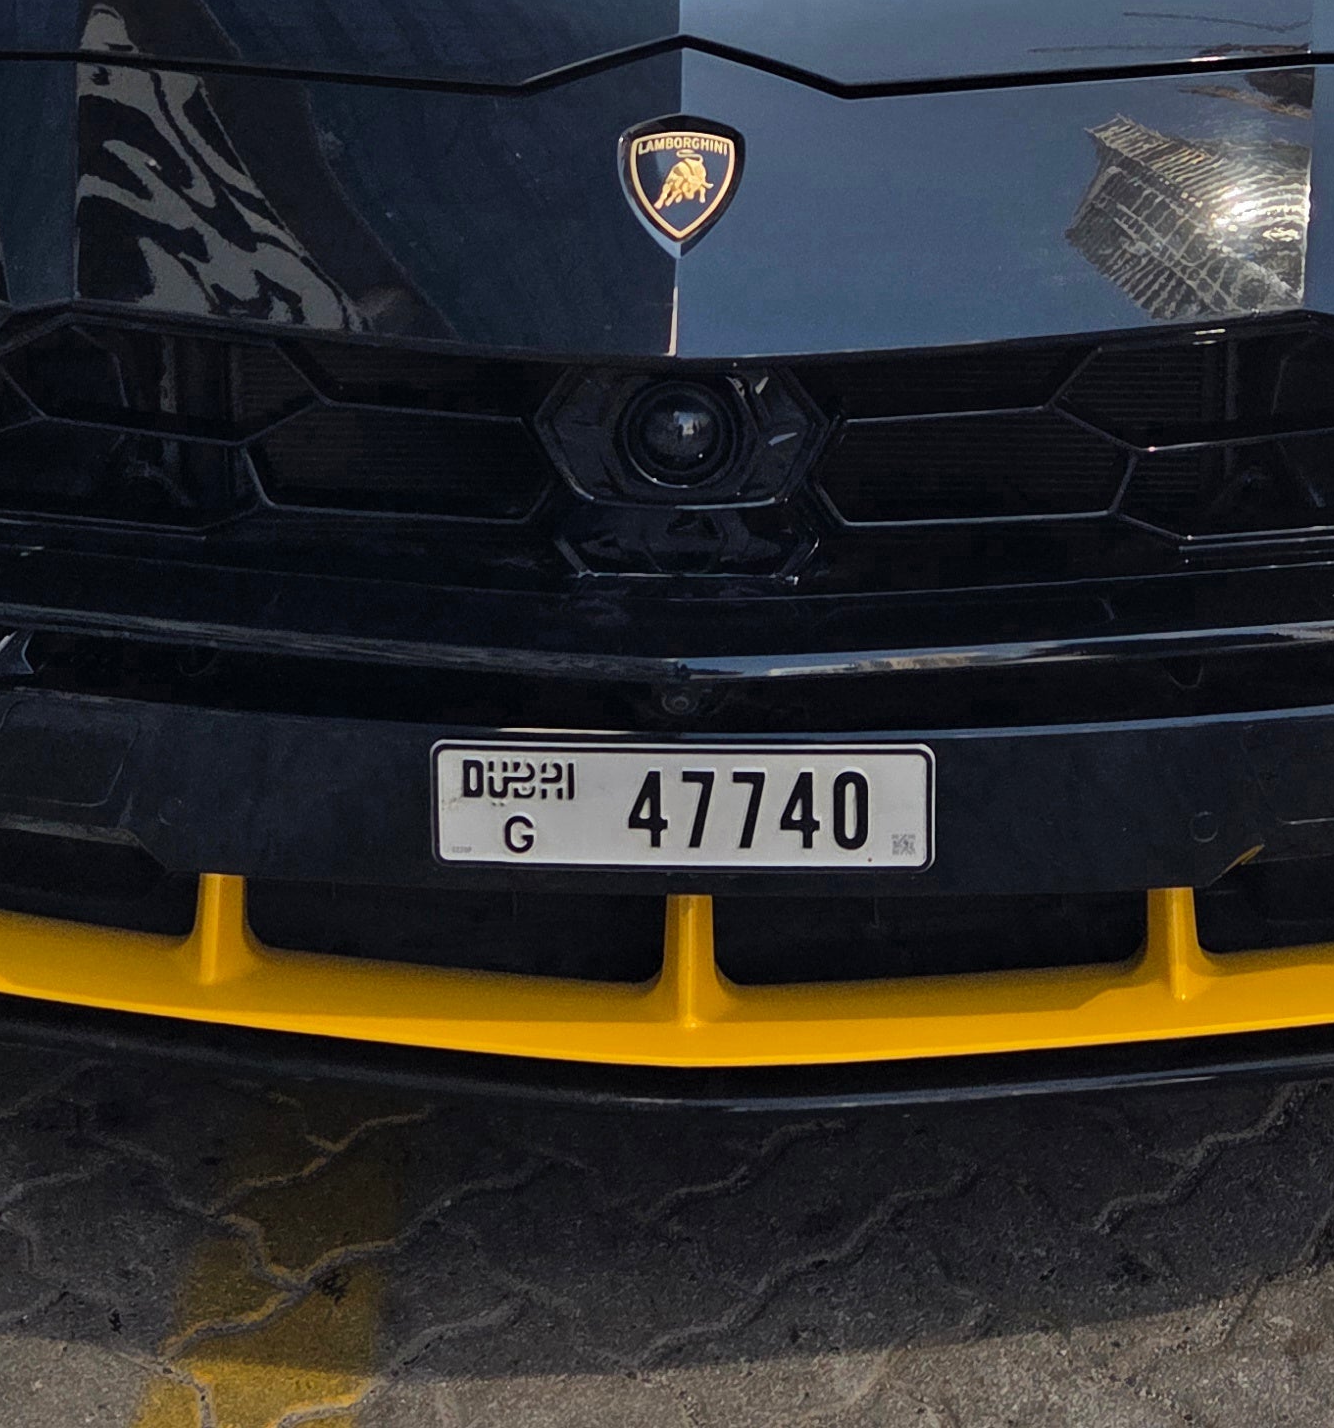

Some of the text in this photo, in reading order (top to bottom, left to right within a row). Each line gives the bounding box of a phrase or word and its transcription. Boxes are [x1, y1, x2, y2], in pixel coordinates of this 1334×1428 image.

[638, 137, 727, 156] LAMBORGHINI
[504, 769, 870, 854] G 47740
